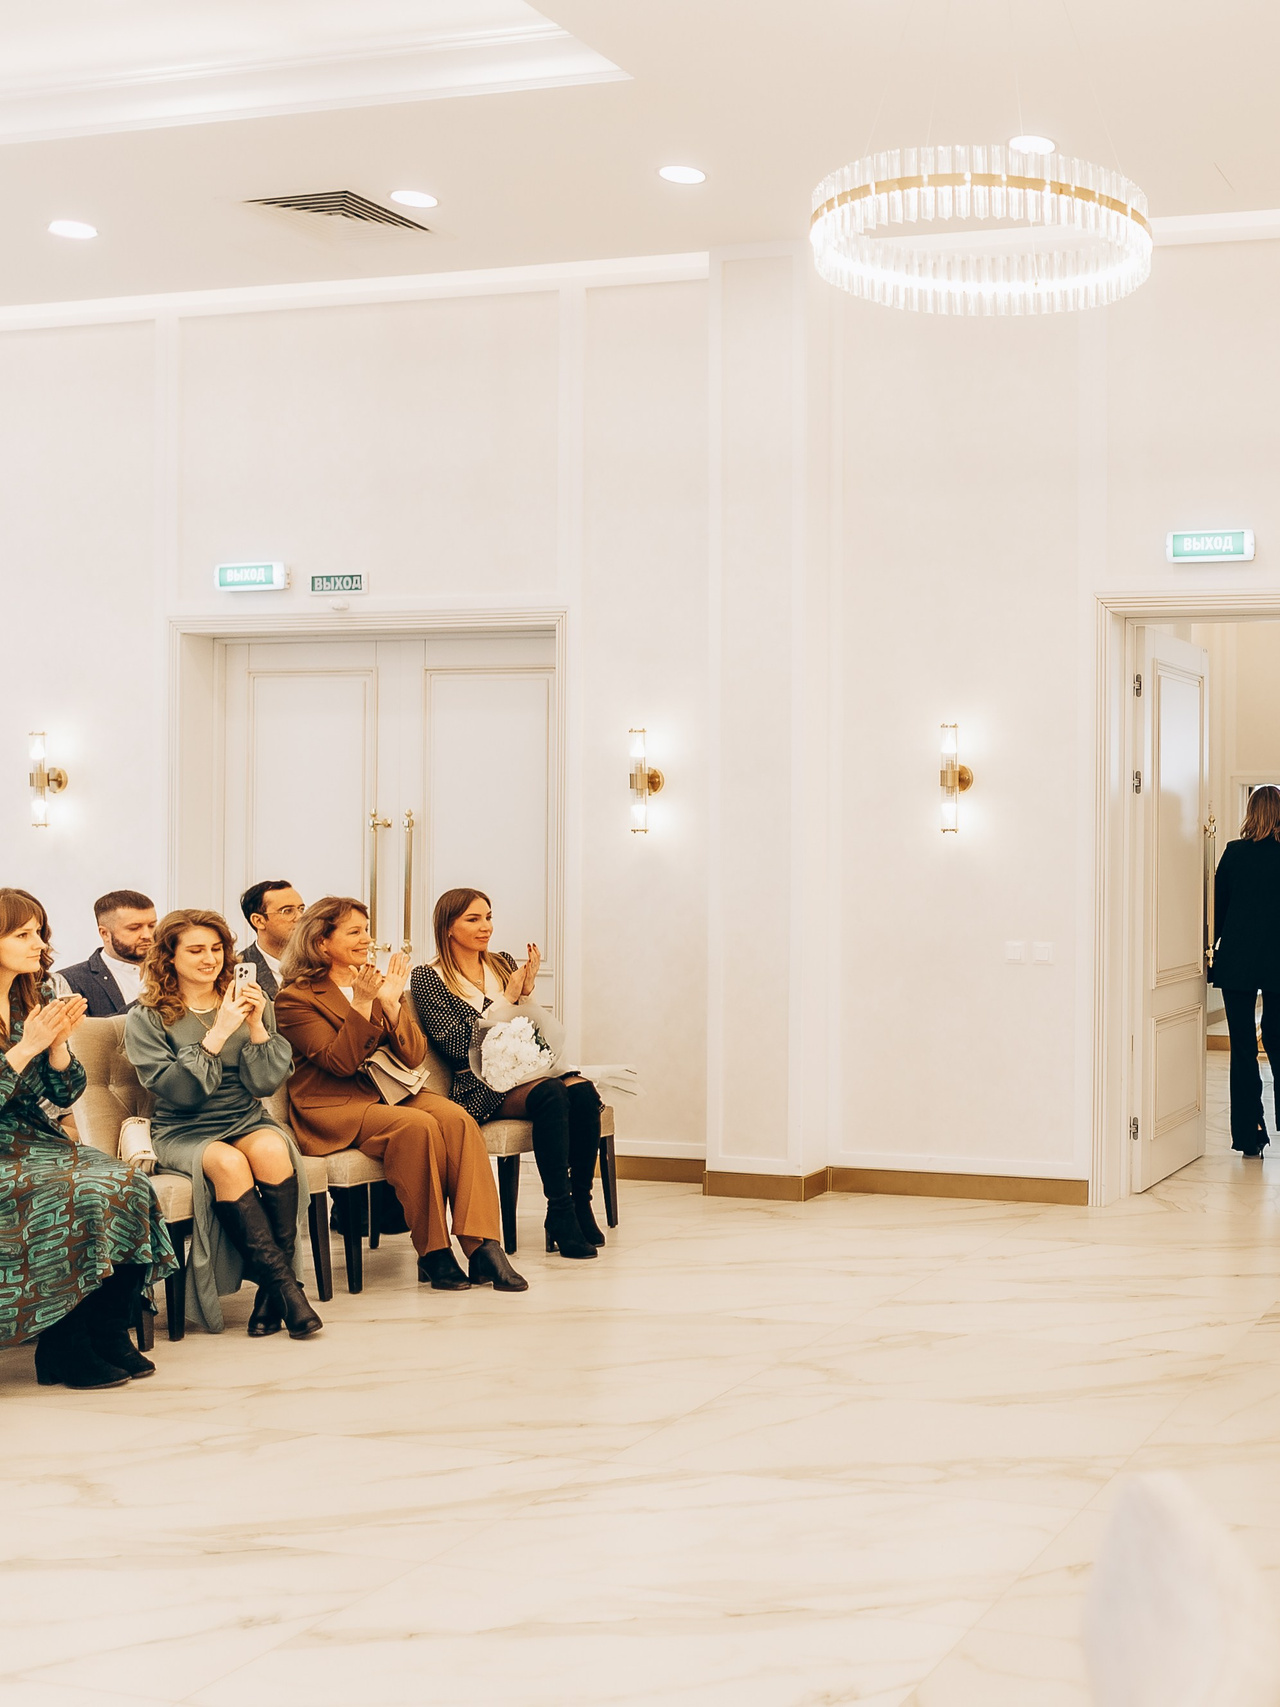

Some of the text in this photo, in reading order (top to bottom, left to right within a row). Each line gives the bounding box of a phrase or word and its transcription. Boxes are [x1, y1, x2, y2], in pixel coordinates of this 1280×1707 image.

[1183, 535, 1234, 552] ВЫХОД
[226, 567, 266, 583] ВЫХОД
[314, 576, 361, 590] ВЫХОД
